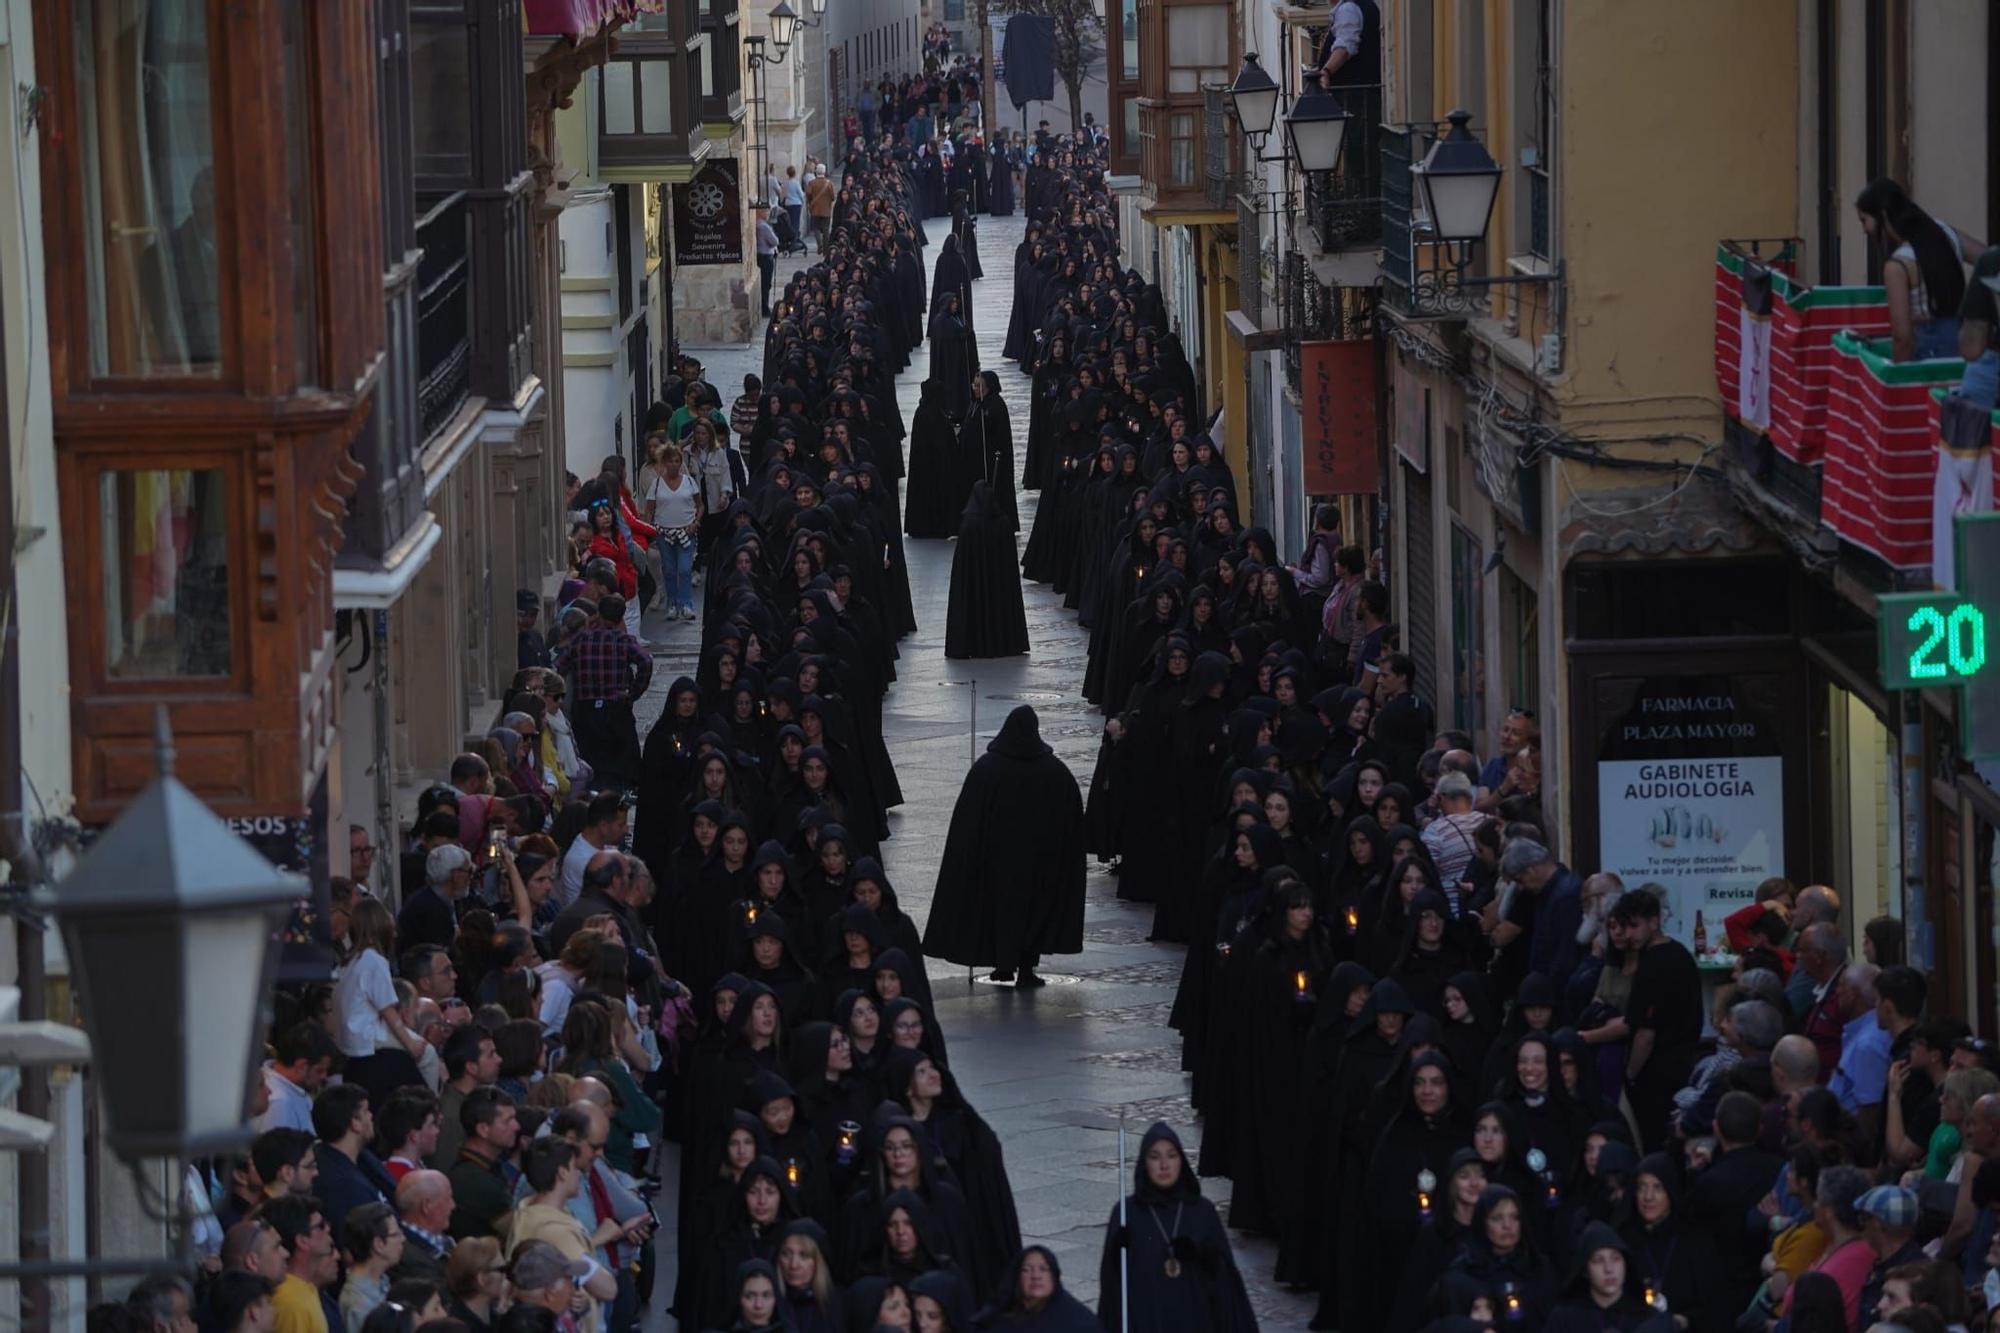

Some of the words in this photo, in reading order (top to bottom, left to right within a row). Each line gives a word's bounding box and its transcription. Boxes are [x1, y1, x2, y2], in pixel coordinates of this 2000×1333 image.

[694, 231, 722, 242] Regalos
[691, 242, 726, 251] Souvenirs
[678, 253, 714, 261] Productos
[1908, 603, 1985, 679] 20
[1641, 696, 1735, 712] FARMACIA
[1623, 725, 1683, 741] PLAZA
[1687, 723, 1756, 739] MAYOR
[1639, 763, 1739, 781] GABINETE
[1624, 781, 1755, 799] AUDIOLOGIA
[1648, 857, 1660, 865] Tu
[1662, 856, 1690, 866] mejor
[1619, 867, 1650, 876] Volver
[1677, 868, 1683, 877] y
[1694, 865, 1739, 874] entender
[1709, 888, 1754, 900] Revisa
